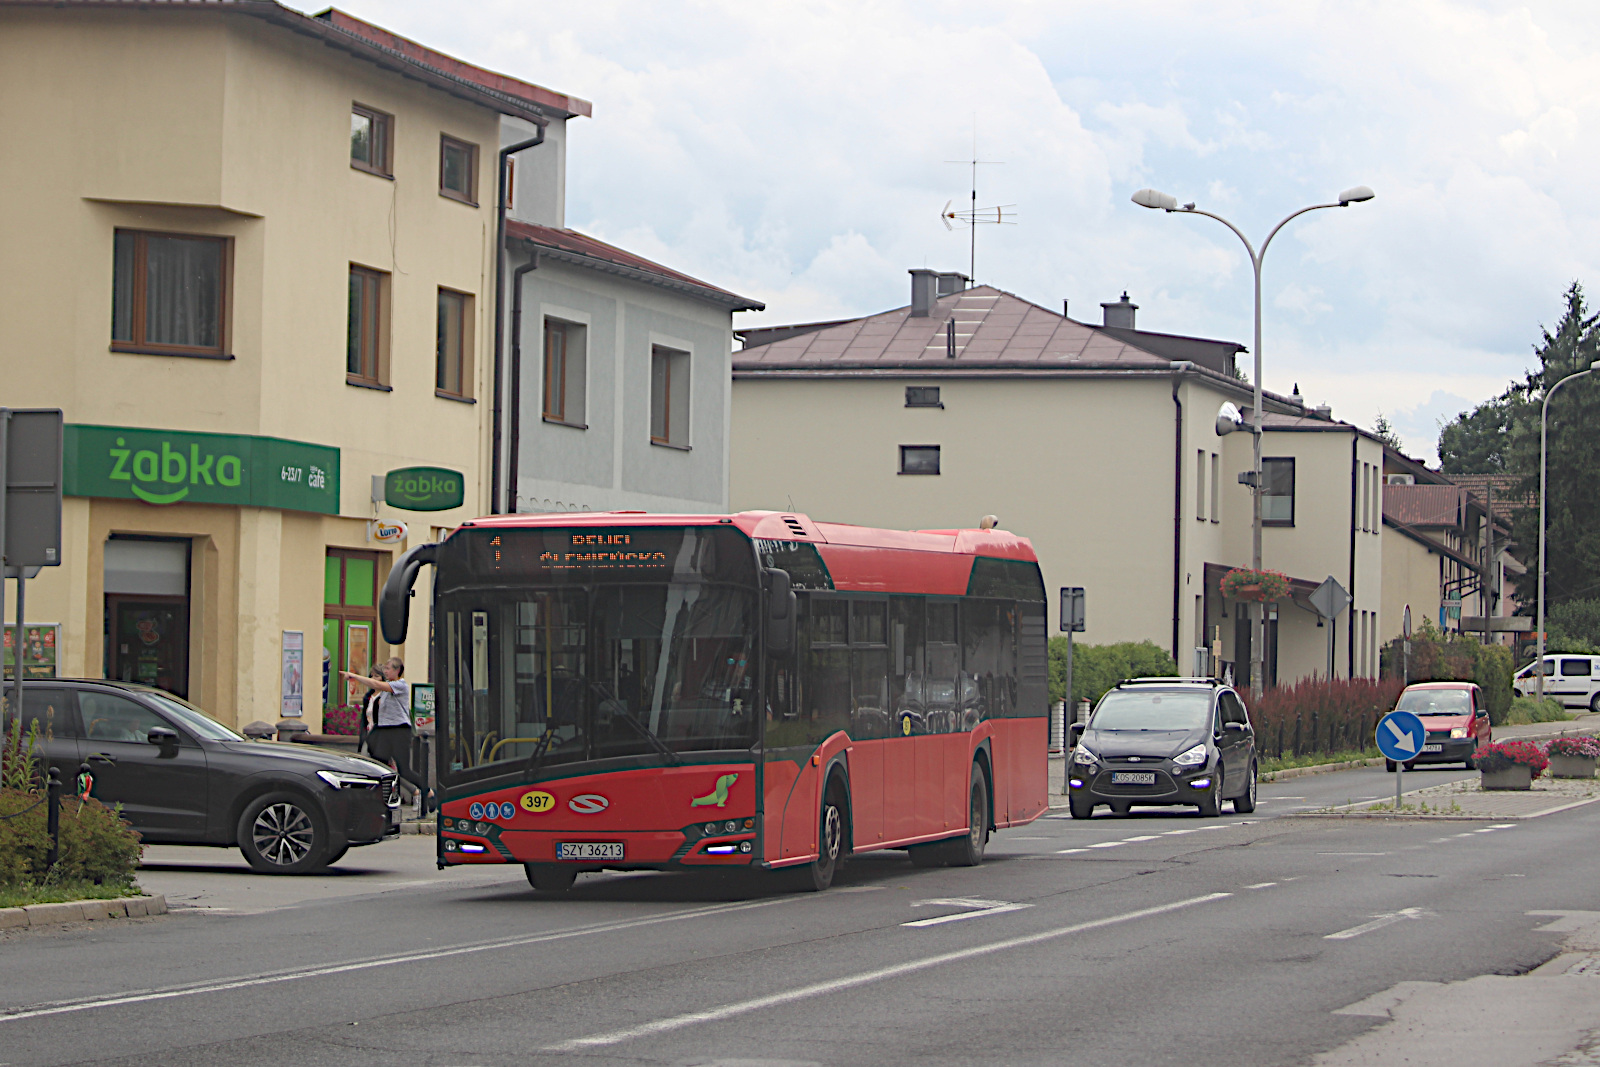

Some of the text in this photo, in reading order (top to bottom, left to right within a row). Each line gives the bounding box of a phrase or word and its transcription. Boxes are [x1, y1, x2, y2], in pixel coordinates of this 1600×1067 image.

[109, 437, 241, 486] żabka
[281, 466, 302, 482] 6-23/7
[394, 475, 456, 493] żabka
[1115, 773, 1130, 782] KOS
[526, 796, 549, 808] 397
[562, 844, 622, 856] SZY 36213
